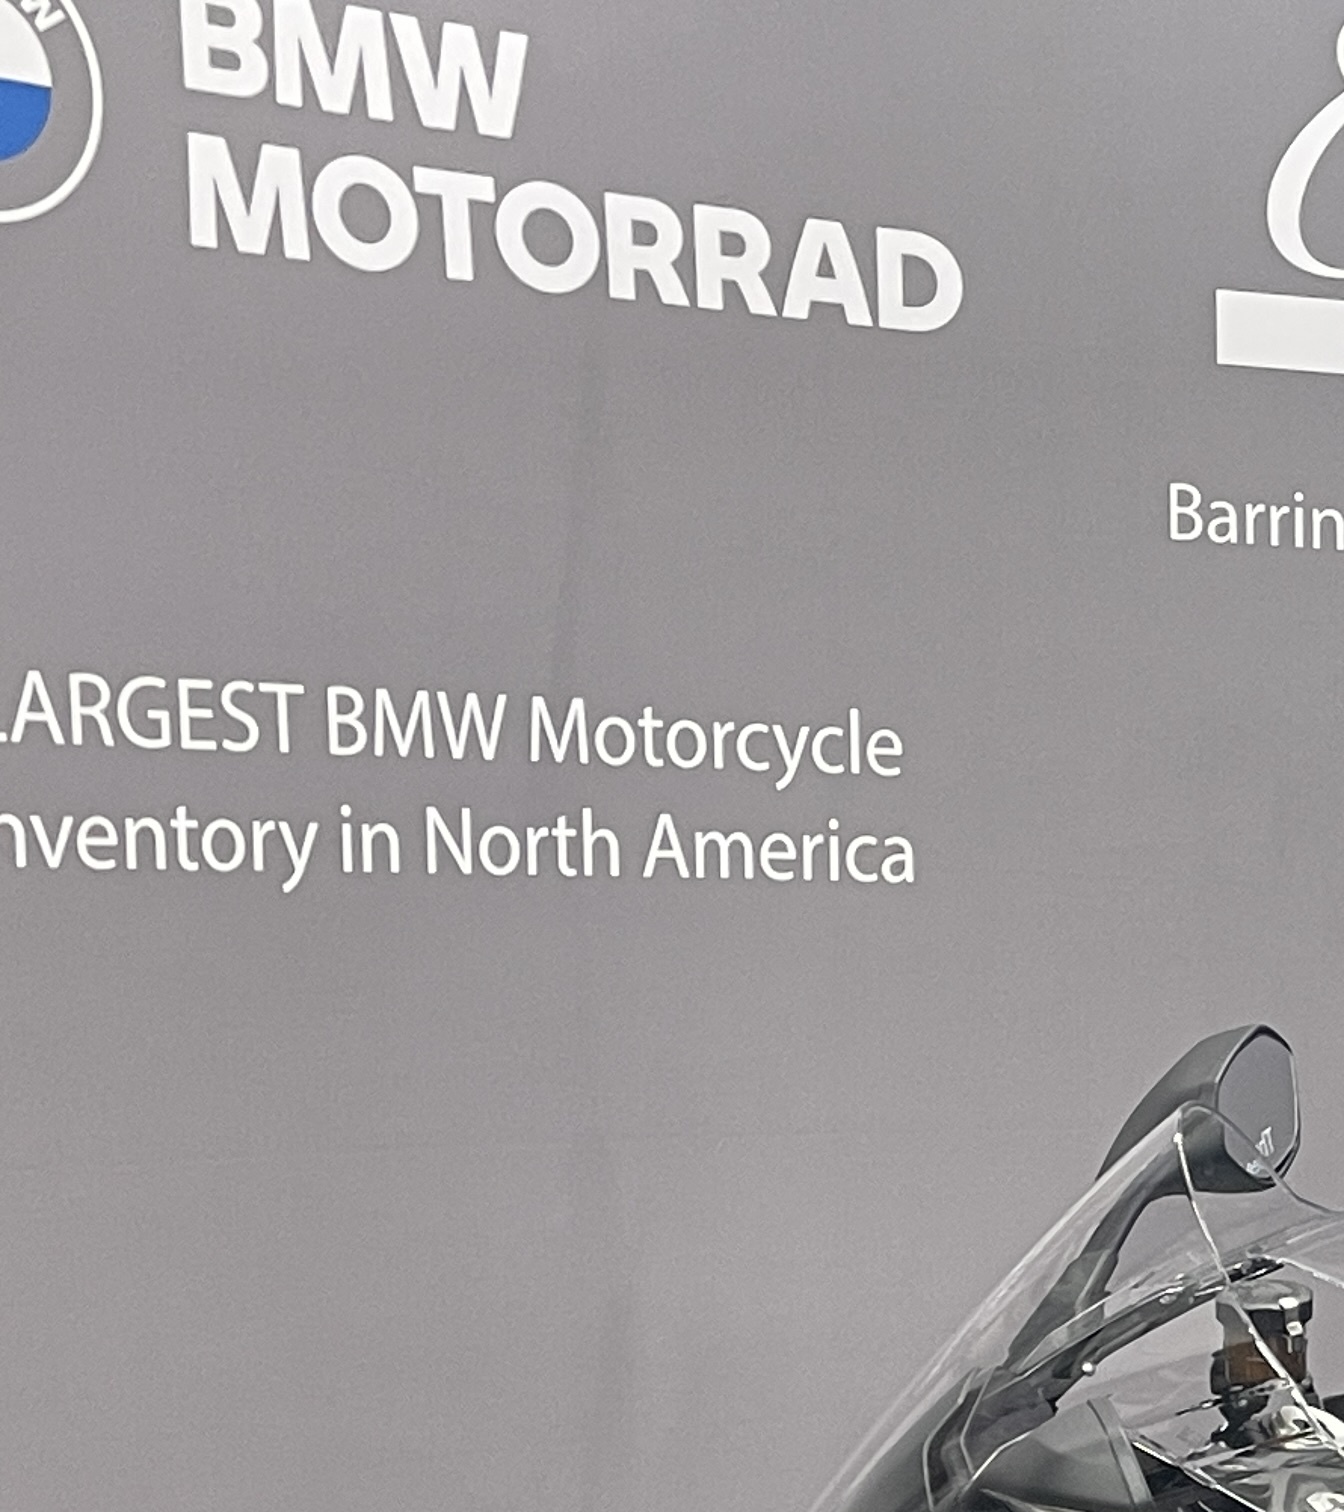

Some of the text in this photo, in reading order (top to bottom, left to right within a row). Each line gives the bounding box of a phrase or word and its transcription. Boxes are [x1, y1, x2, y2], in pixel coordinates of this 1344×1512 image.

[180, 0, 528, 139] BMW
[187, 131, 964, 332] MOTORRAD
[0, 670, 904, 791] ARGEST BMW Motorcycle
[0, 804, 915, 894] nventory in North America
